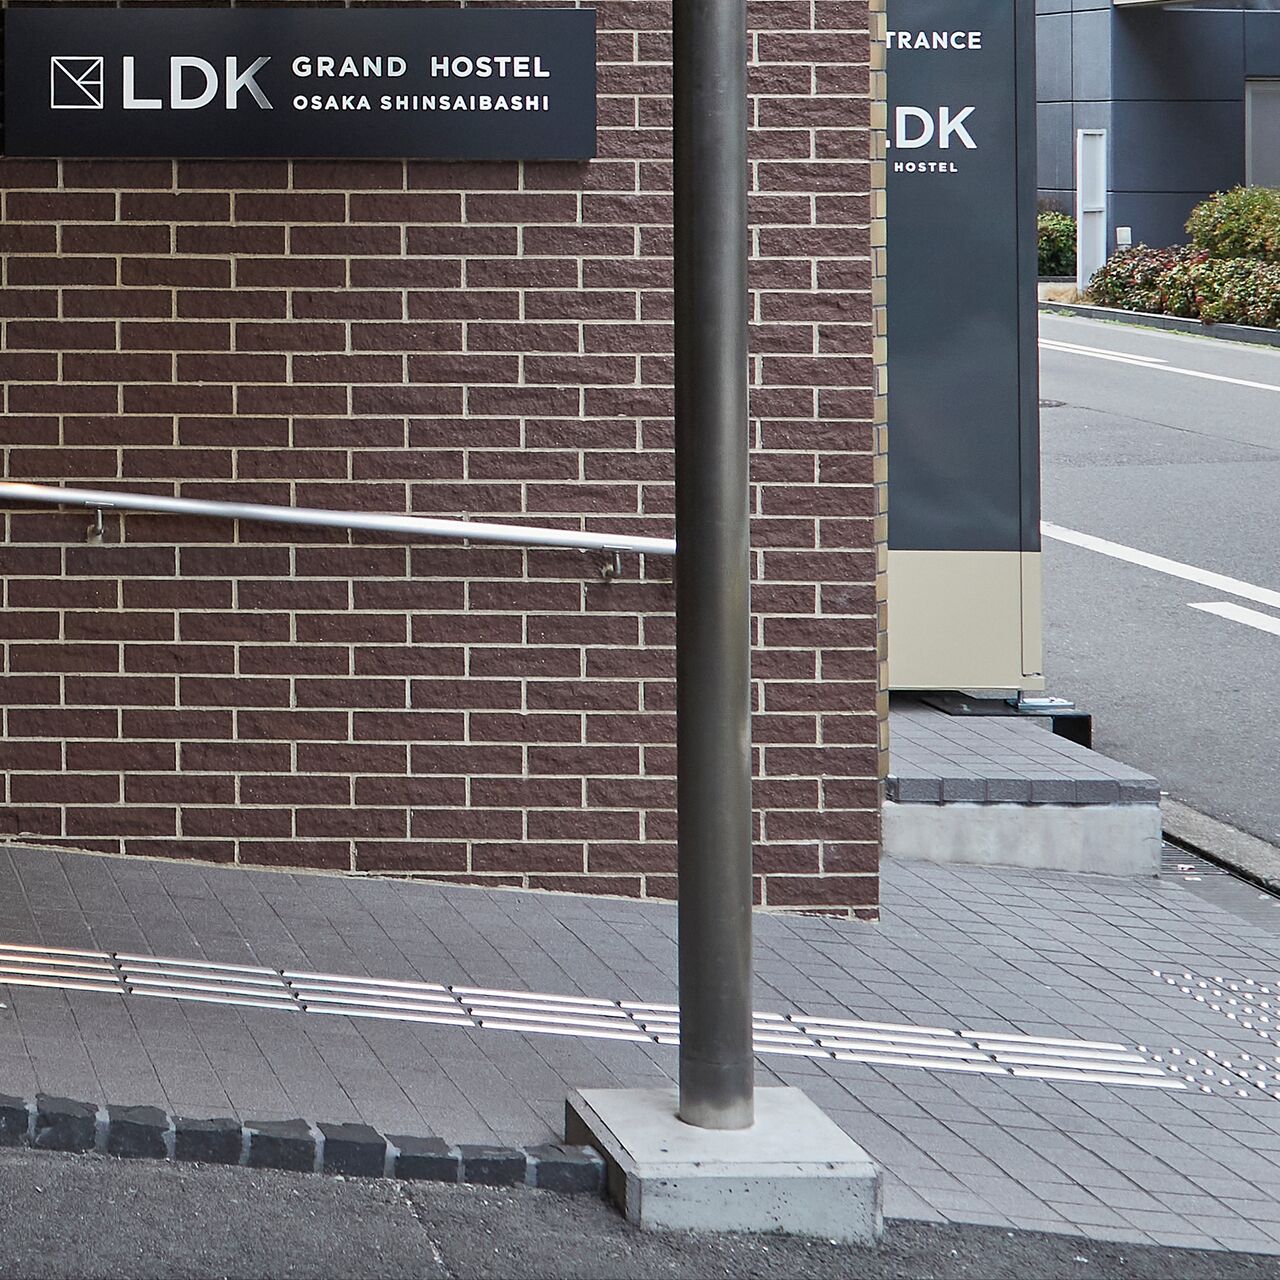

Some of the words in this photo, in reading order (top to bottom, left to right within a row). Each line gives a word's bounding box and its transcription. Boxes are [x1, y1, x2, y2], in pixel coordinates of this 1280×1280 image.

[886, 31, 982, 49] TRANCE
[123, 57, 274, 110] LDK
[292, 56, 407, 78] GRAND
[431, 56, 550, 78] HOSTEL
[293, 95, 372, 111] OSAKA
[380, 95, 550, 111] SHINSAIBASHI
[886, 106, 978, 149] DK
[894, 162, 958, 173] HOSTEL
